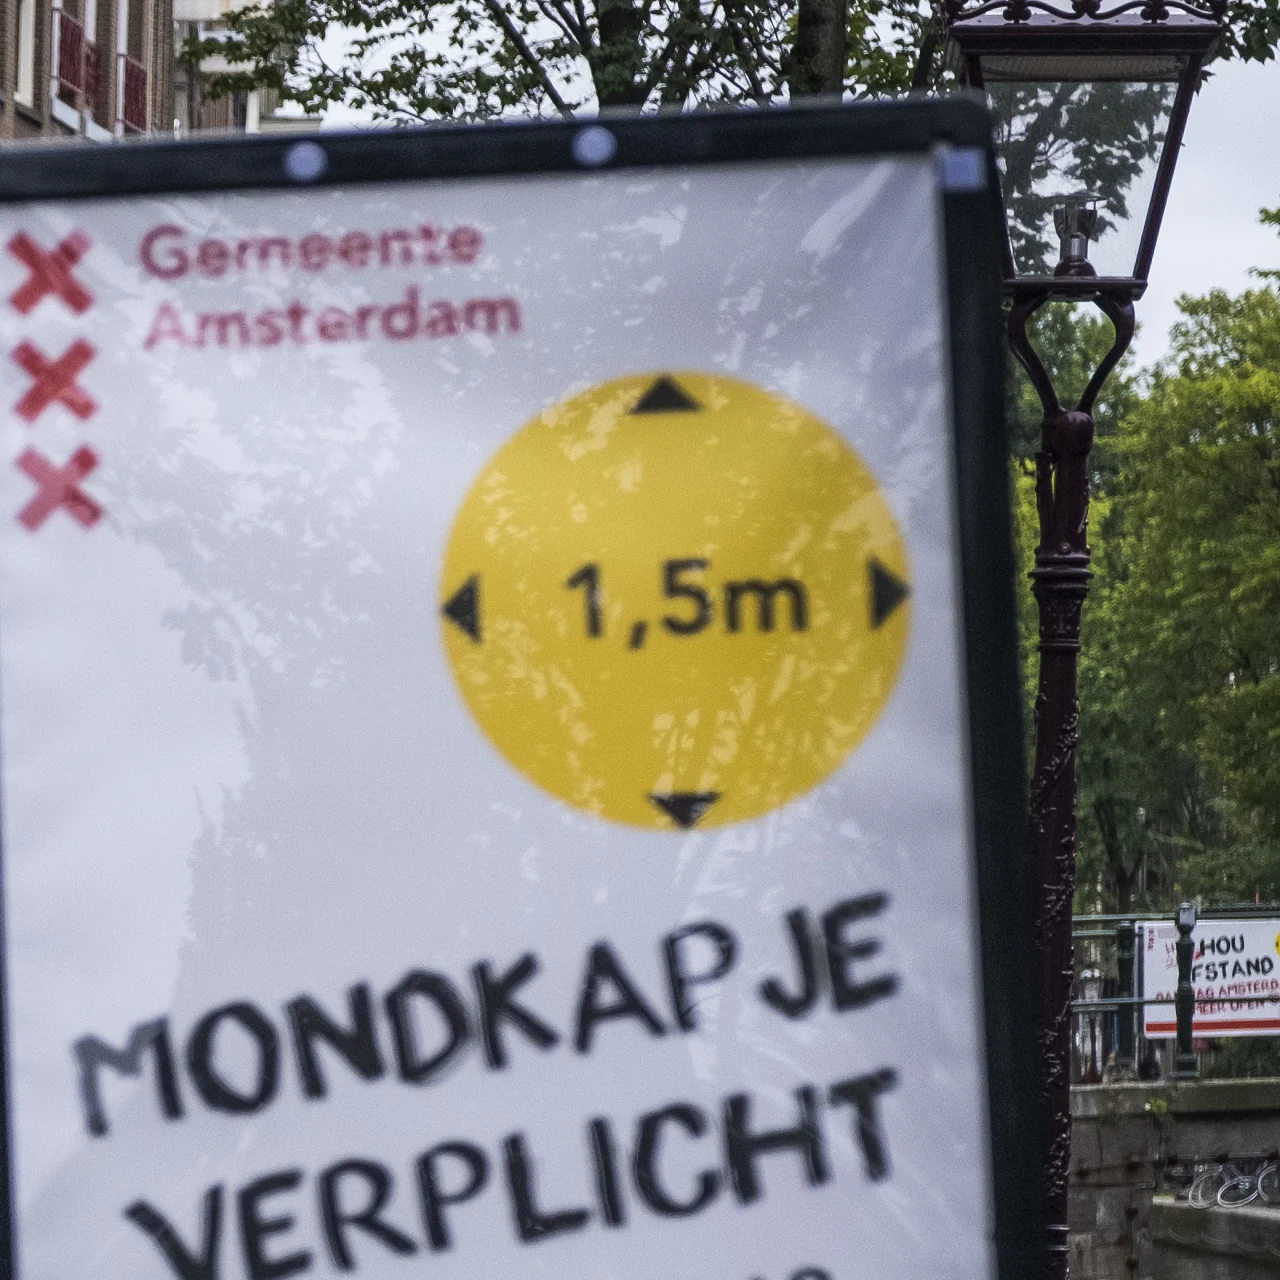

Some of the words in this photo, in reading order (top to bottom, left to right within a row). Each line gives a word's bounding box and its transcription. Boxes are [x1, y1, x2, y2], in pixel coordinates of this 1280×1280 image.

[136, 220, 484, 284] Gemeente
[142, 284, 524, 351] Amsterdam
[565, 556, 812, 652] 1,5m
[1191, 955, 1274, 982] FSTAND
[1199, 933, 1245, 957] HOU
[72, 889, 903, 1140] MONDKAPJE
